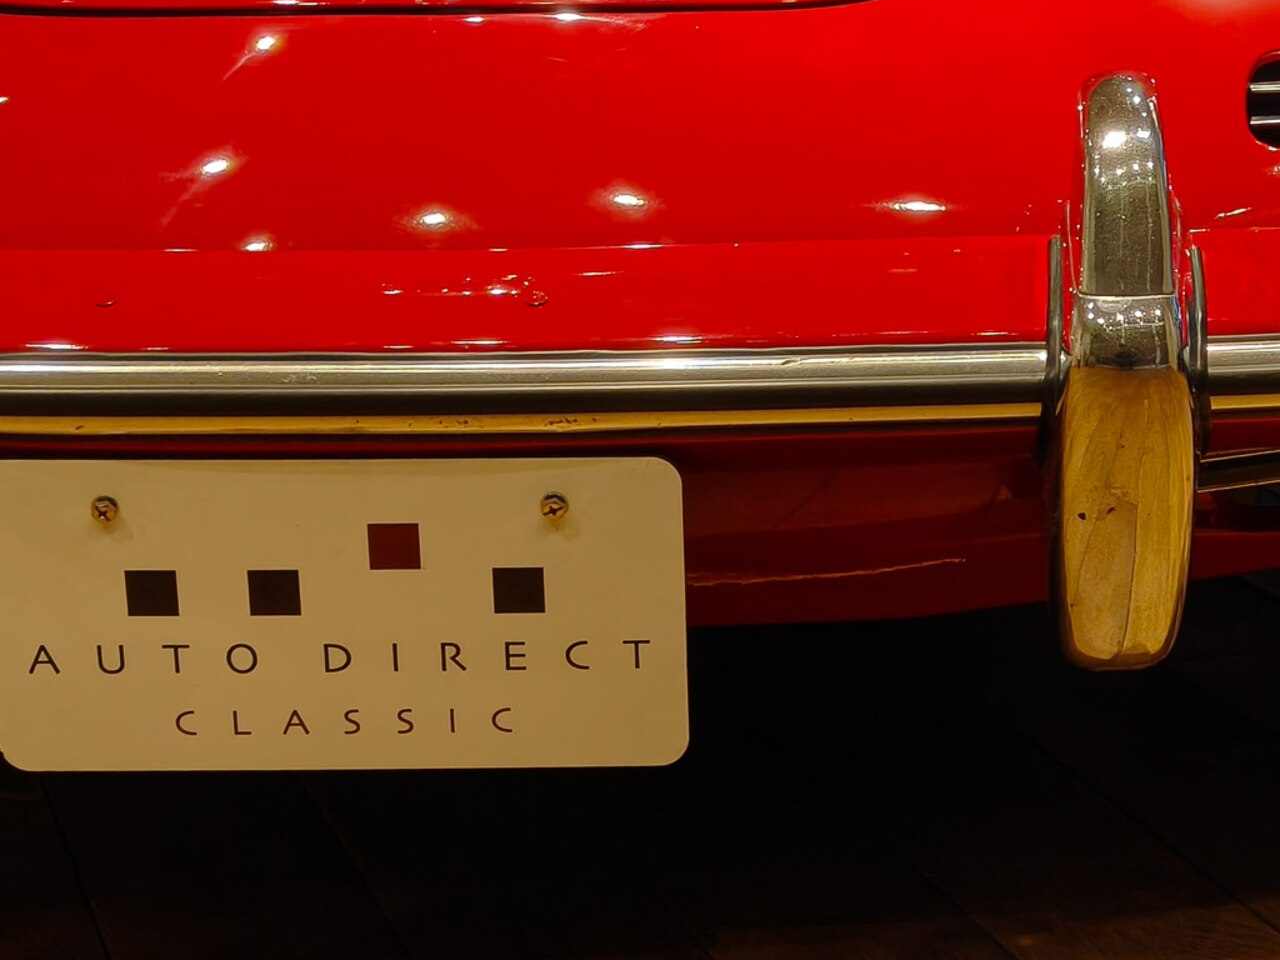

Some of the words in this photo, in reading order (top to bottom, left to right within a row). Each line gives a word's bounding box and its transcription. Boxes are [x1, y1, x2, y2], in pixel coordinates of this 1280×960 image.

[28, 643, 259, 675] AUTO
[322, 640, 651, 673] DIRECT
[175, 707, 513, 735] CLASSIC
